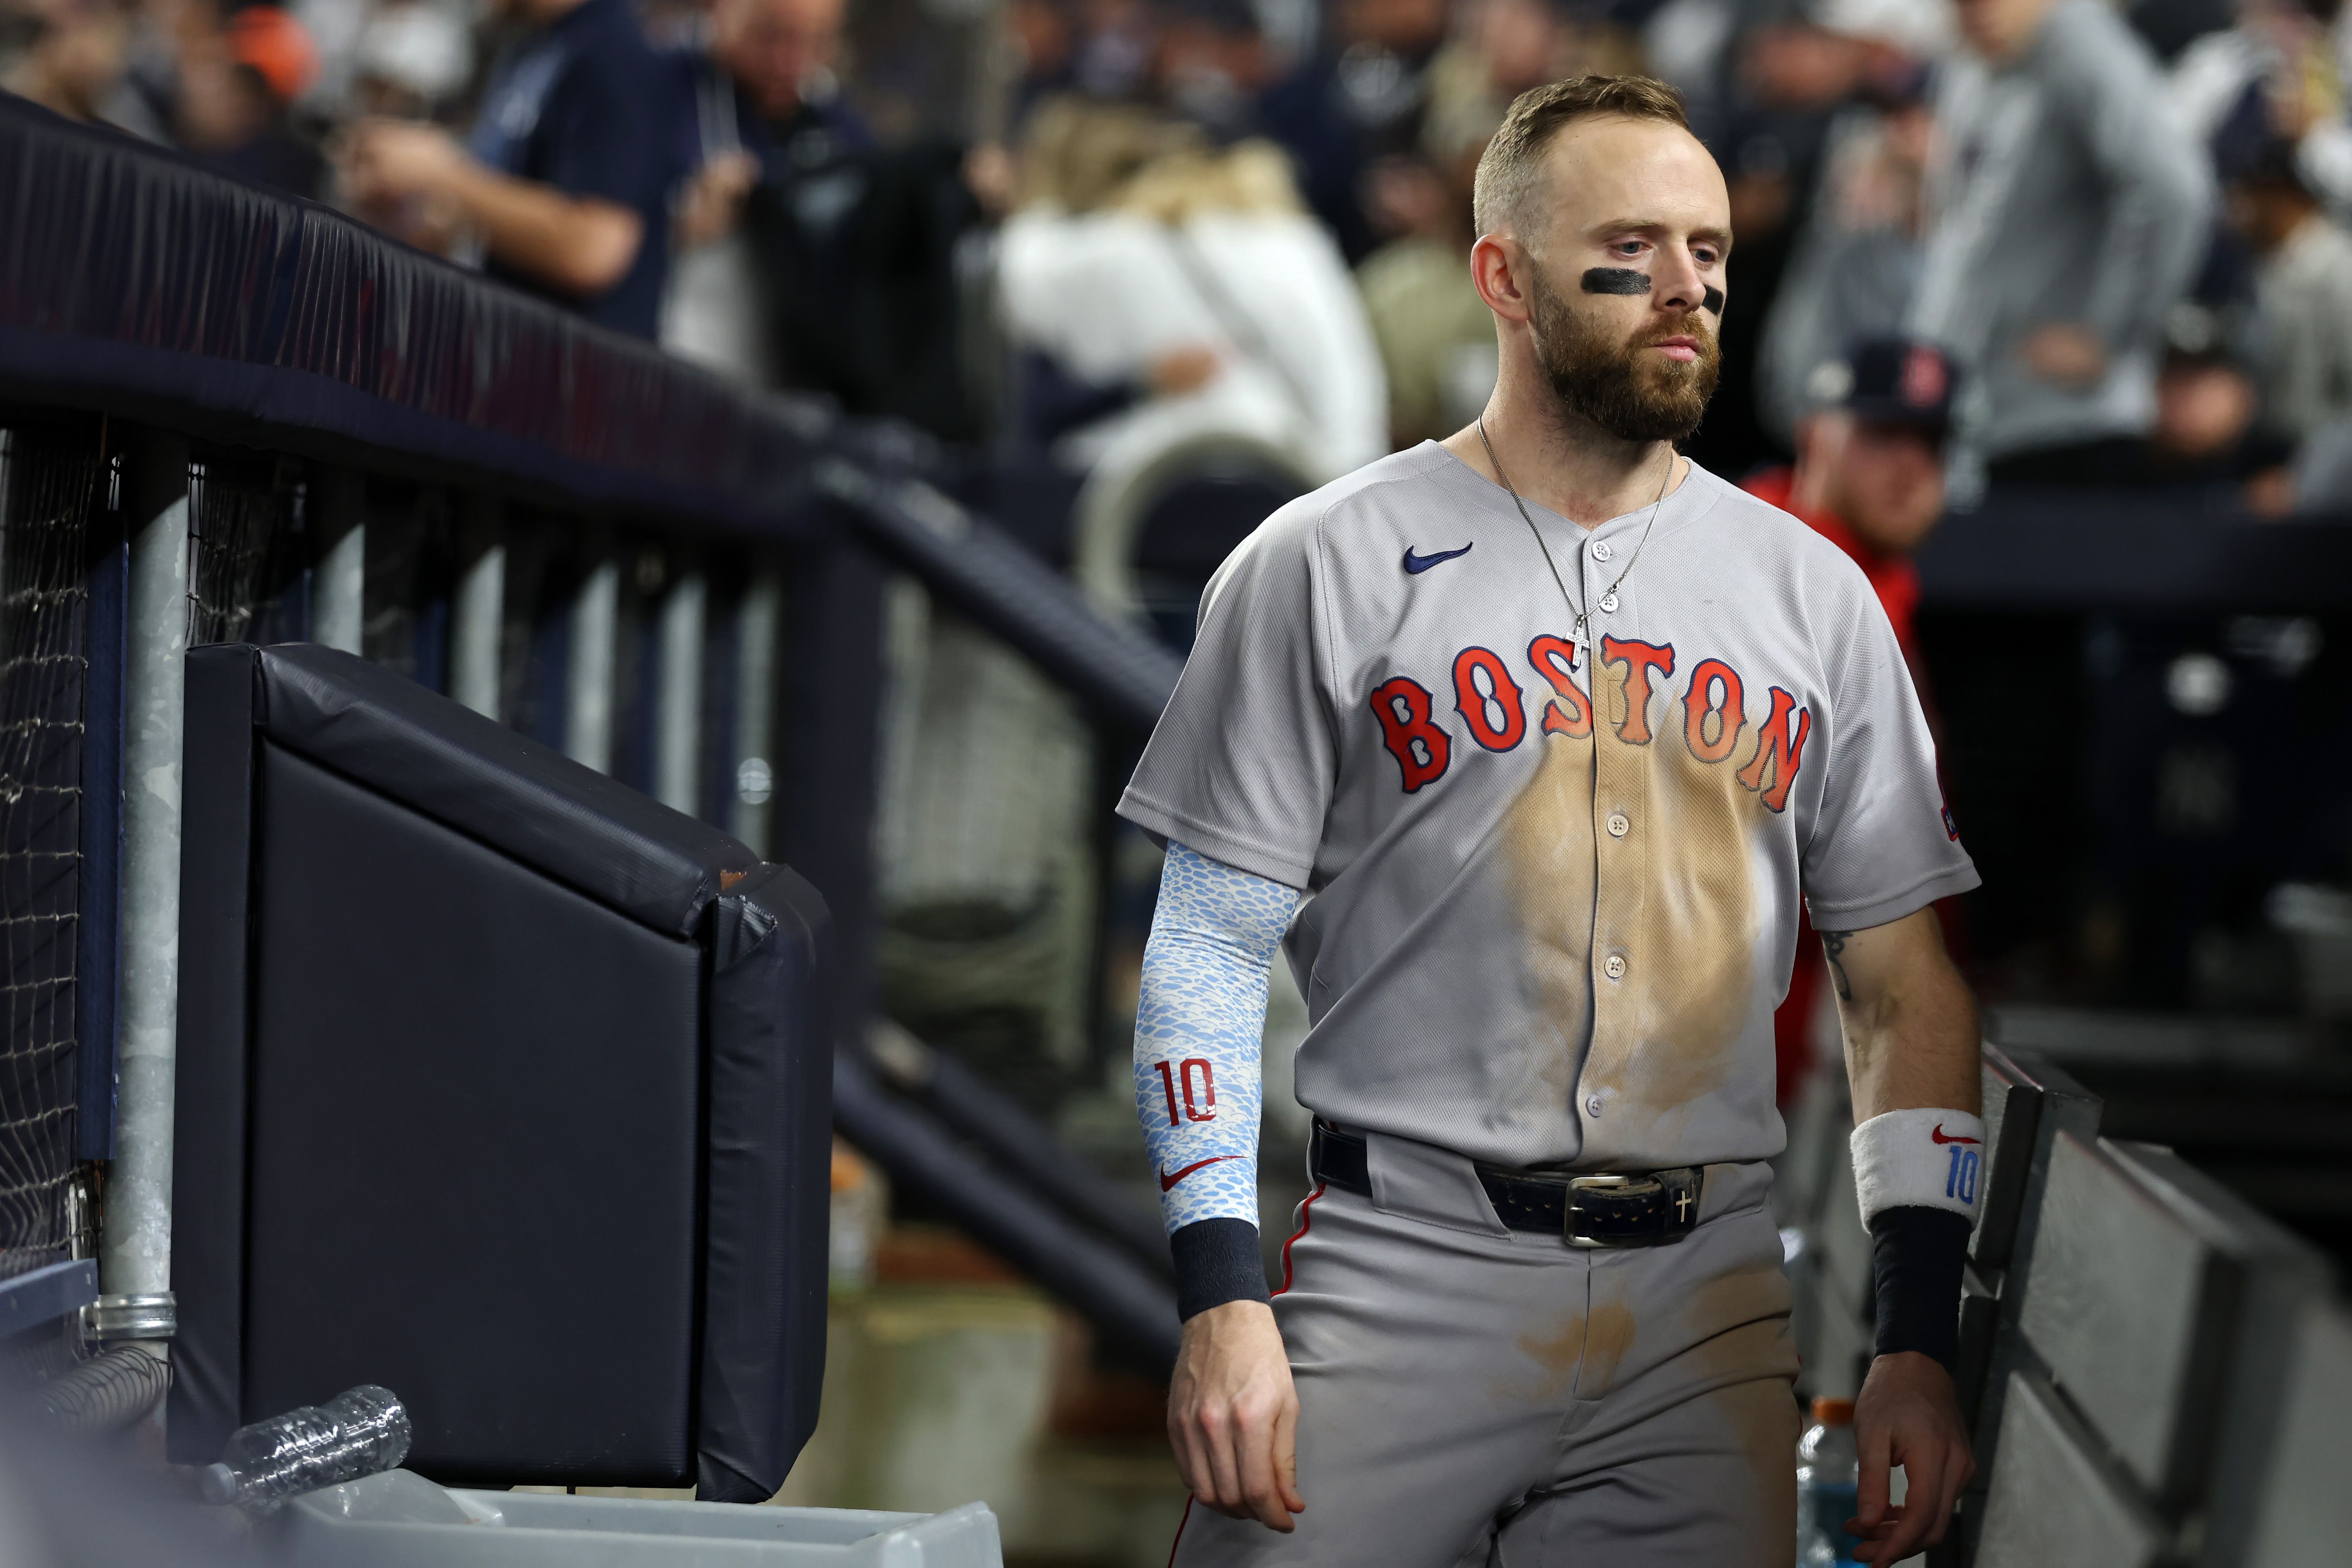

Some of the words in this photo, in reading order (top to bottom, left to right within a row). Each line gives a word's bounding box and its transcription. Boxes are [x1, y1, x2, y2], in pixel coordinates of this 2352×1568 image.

[1370, 633, 1810, 813] BOSTON
[1154, 1058, 1216, 1126] 10
[1946, 1145, 1978, 1205] 10
